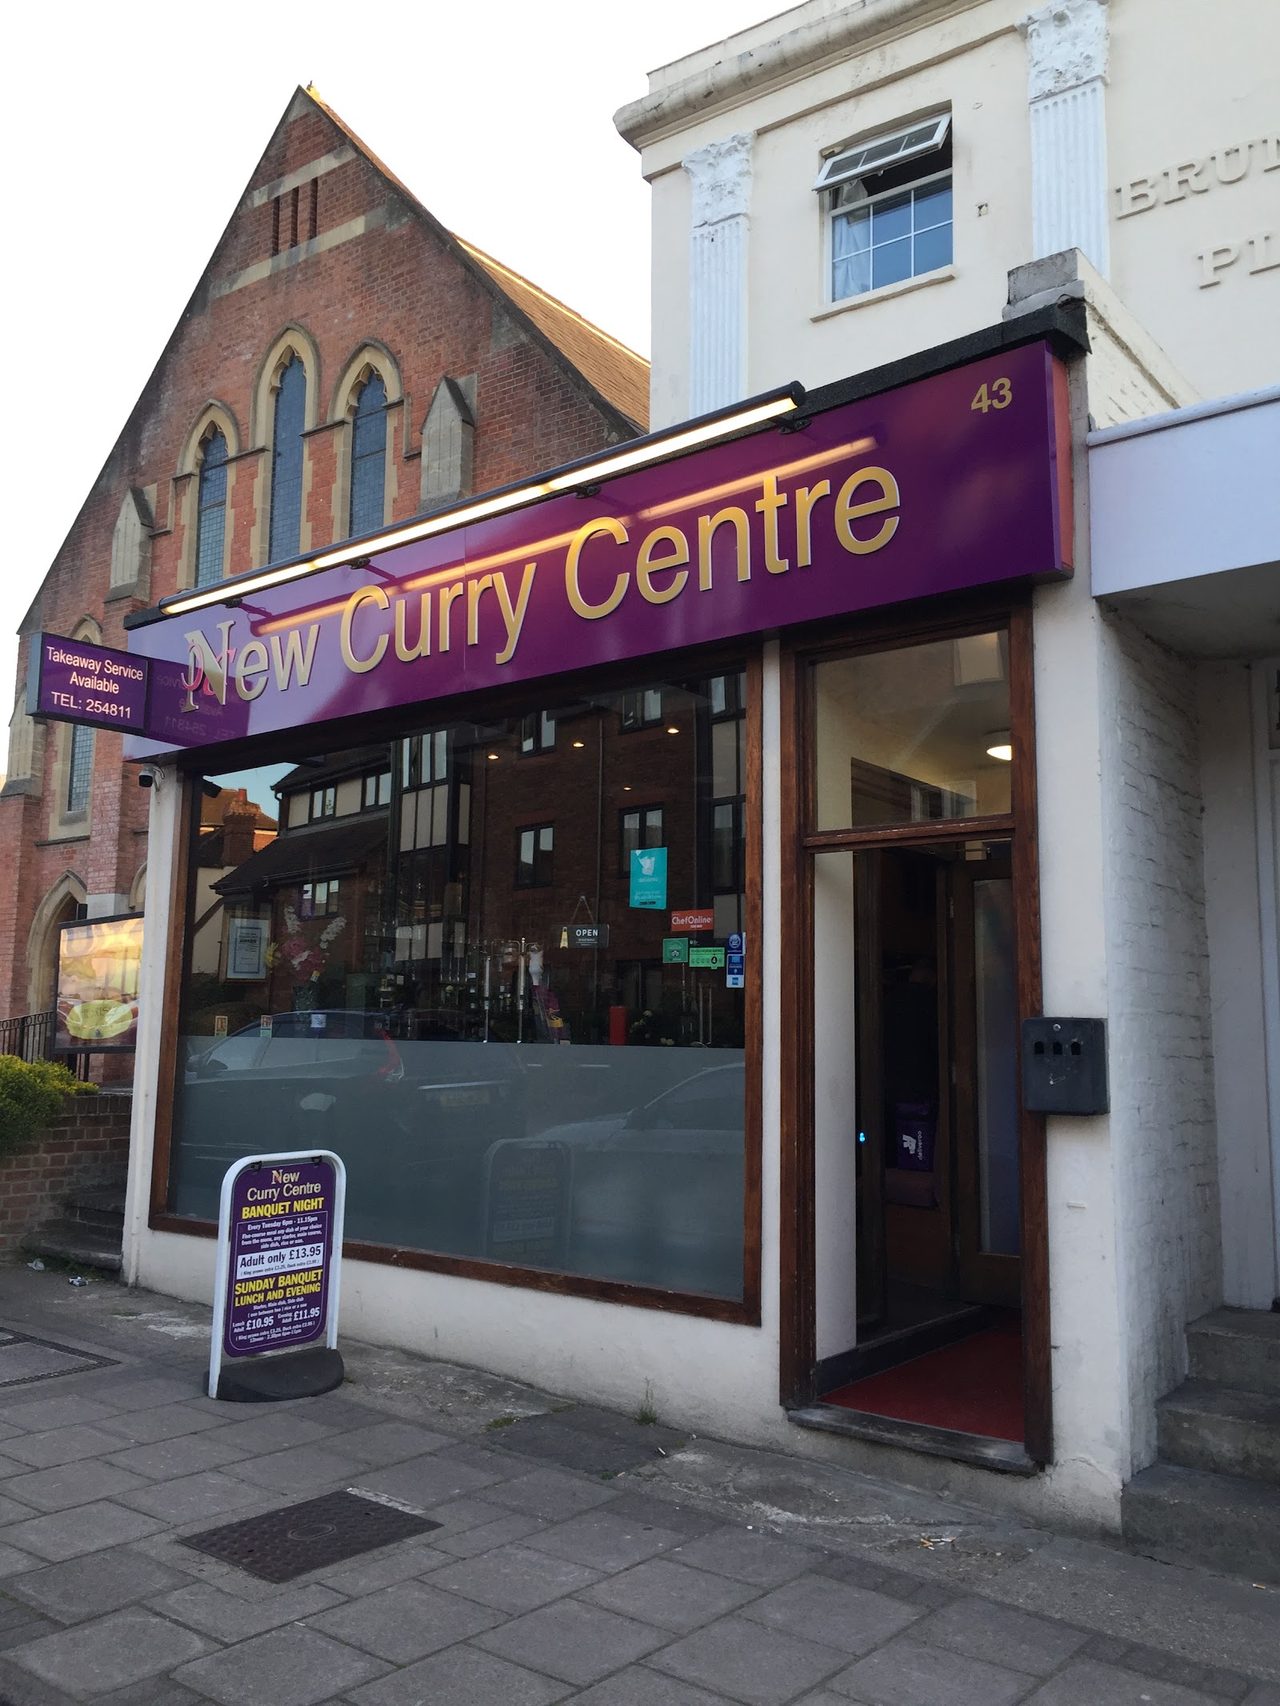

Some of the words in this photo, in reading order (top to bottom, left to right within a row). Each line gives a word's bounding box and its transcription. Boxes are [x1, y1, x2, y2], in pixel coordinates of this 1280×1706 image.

[1115, 138, 1280, 220] BRU
[970, 377, 1013, 414] 43
[181, 620, 320, 713] New
[340, 561, 537, 673] Curry
[564, 465, 901, 620] Centre
[46, 646, 102, 671] Takeaway
[104, 661, 144, 682] Service
[70, 671, 120, 695] Available
[51, 691, 82, 710] TEL:
[85, 698, 131, 719] 254811
[671, 915, 712, 925] ChefOnline
[575, 928, 599, 937] OPEN
[271, 1169, 300, 1185] New
[247, 1187, 281, 1202] Curry
[283, 1183, 321, 1197] Centre
[242, 1202, 291, 1220] BANQUET
[293, 1197, 325, 1213] NIGHT
[240, 1255, 265, 1267] Adult
[268, 1251, 286, 1263] only
[290, 1246, 321, 1260] £13.95
[235, 1277, 275, 1295] SUNDAY
[278, 1269, 322, 1287] BANQUET
[235, 1293, 264, 1306] LUNCH
[267, 1289, 284, 1300] AND
[286, 1283, 321, 1297] EVENING
[246, 1316, 274, 1330] £10.95
[294, 1307, 320, 1321] £11.95
